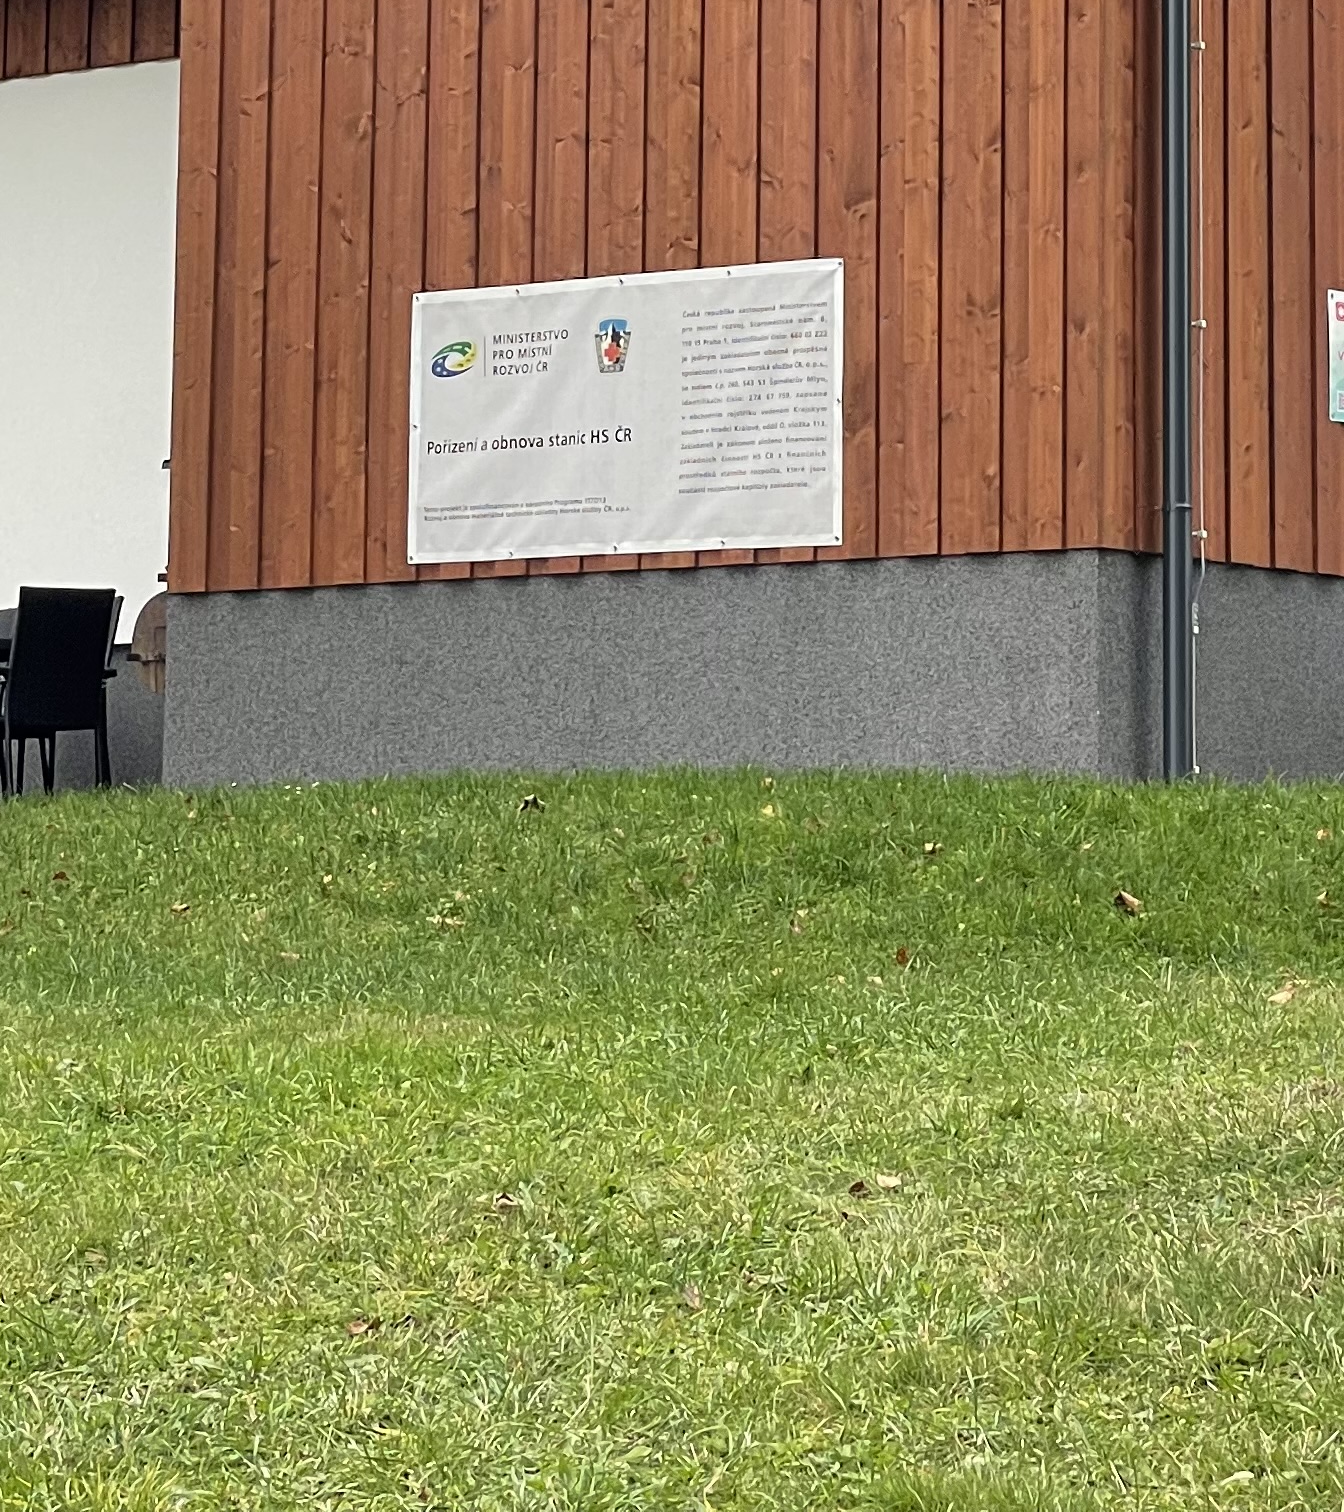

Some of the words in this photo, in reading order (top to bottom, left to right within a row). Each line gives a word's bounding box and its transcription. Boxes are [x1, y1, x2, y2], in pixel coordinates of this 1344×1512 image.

[492, 329, 569, 345] MINISTERSTVO
[492, 348, 514, 361] PRO
[517, 345, 552, 359] MÍSTNÍ
[492, 363, 533, 376] ROZVOJ
[535, 361, 549, 373] ČR
[427, 437, 479, 455] Pořízení
[480, 440, 488, 452] a
[491, 434, 544, 450] obnova
[548, 429, 586, 447] stanic
[590, 429, 609, 444] HS
[614, 425, 632, 443] ČR
